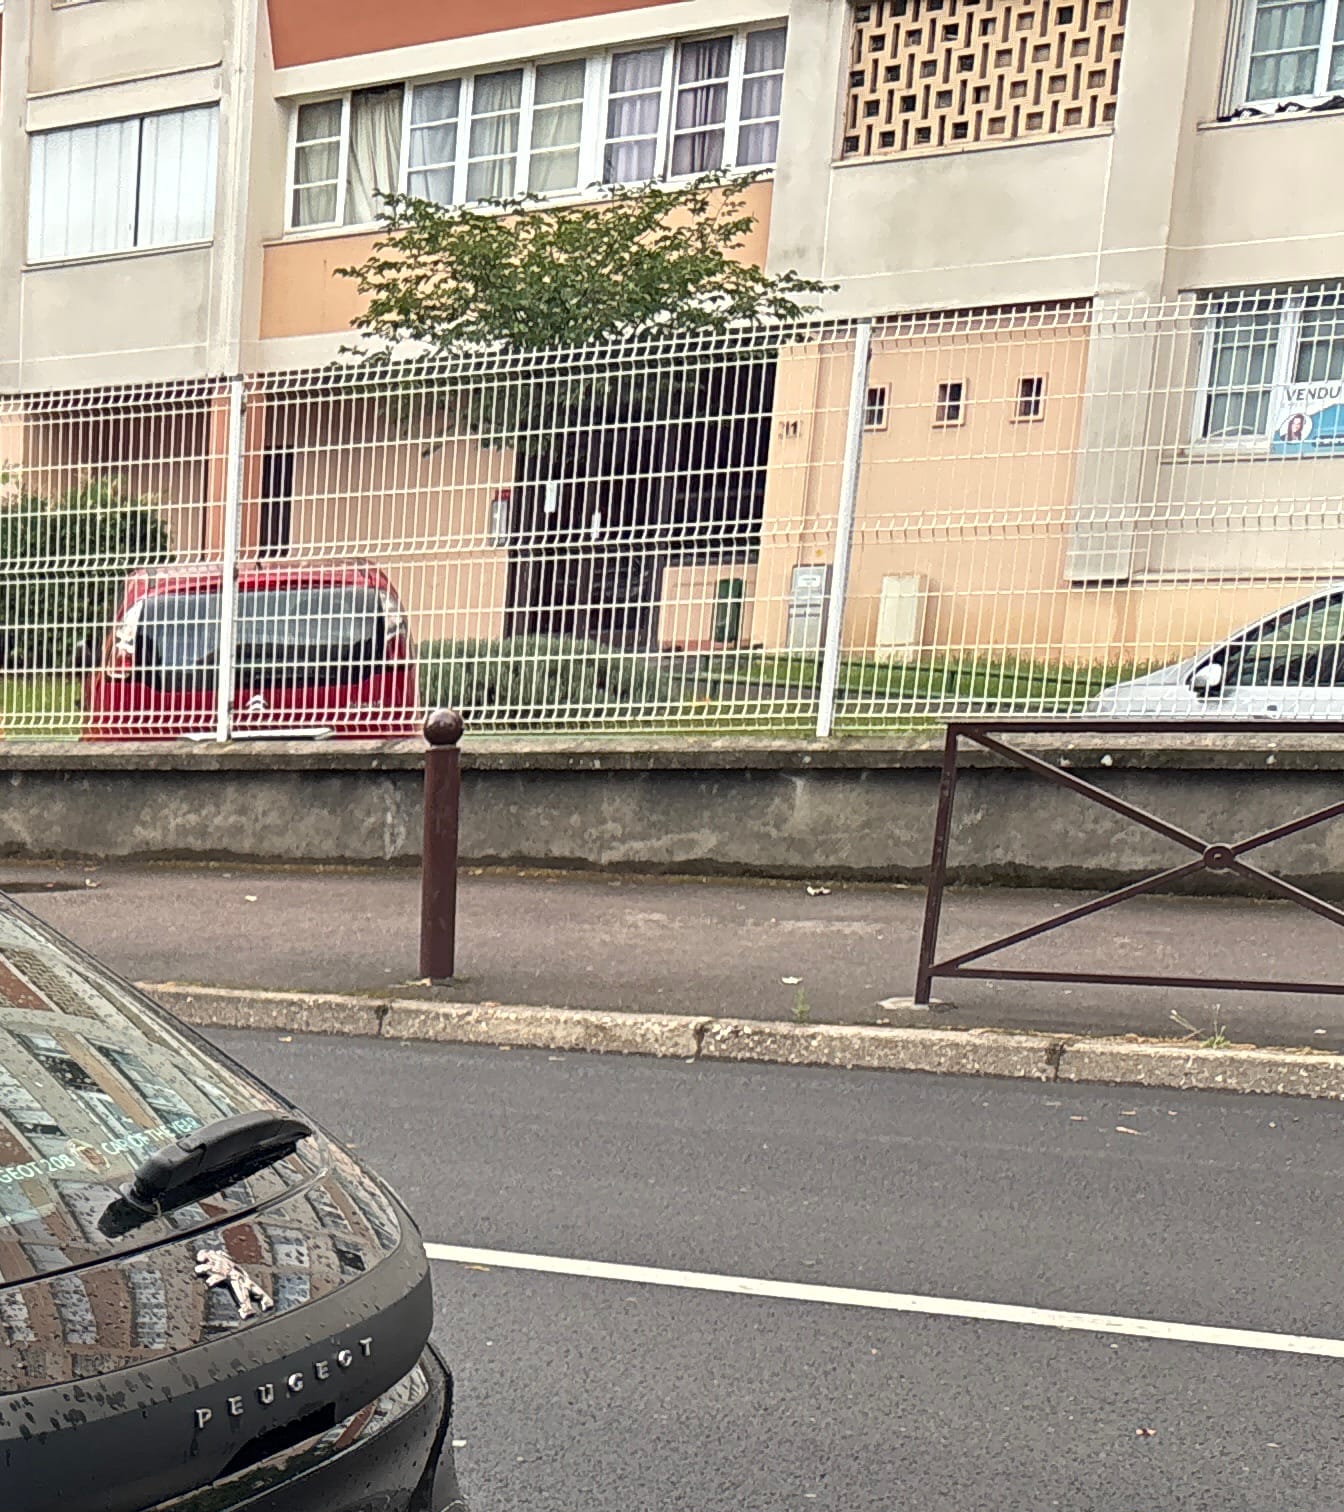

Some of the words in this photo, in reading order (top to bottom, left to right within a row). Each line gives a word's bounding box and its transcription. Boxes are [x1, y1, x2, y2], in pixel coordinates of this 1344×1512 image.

[1286, 386, 1341, 401] VENDU
[46, 1153, 76, 1175] 208
[101, 1138, 129, 1156] CAR
[127, 1133, 151, 1148] OF
[144, 1125, 176, 1142] THE
[196, 1337, 373, 1429] PEUGEOT
